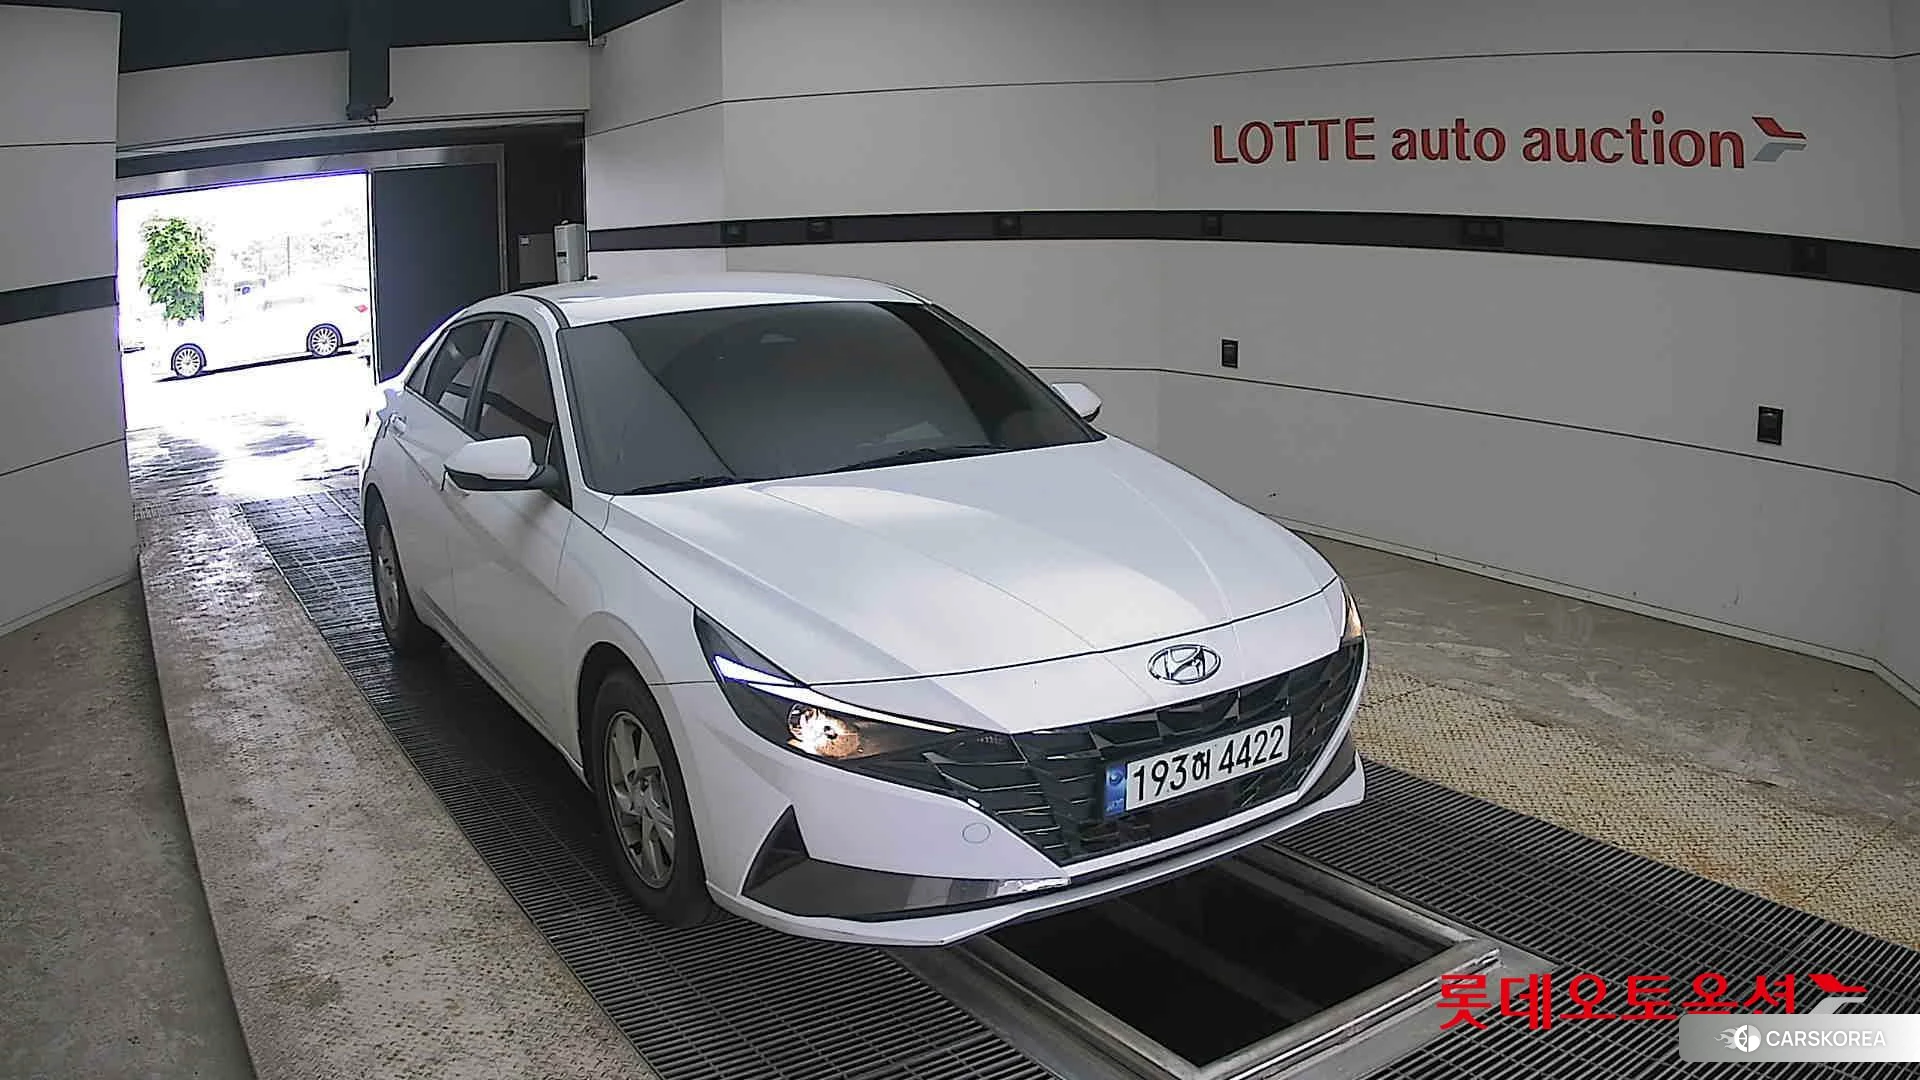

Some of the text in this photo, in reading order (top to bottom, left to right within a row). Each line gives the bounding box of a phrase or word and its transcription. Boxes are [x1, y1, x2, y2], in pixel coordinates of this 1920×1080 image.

[1212, 110, 1746, 169] LOTTE auto auction
[1219, 724, 1285, 774] 4422
